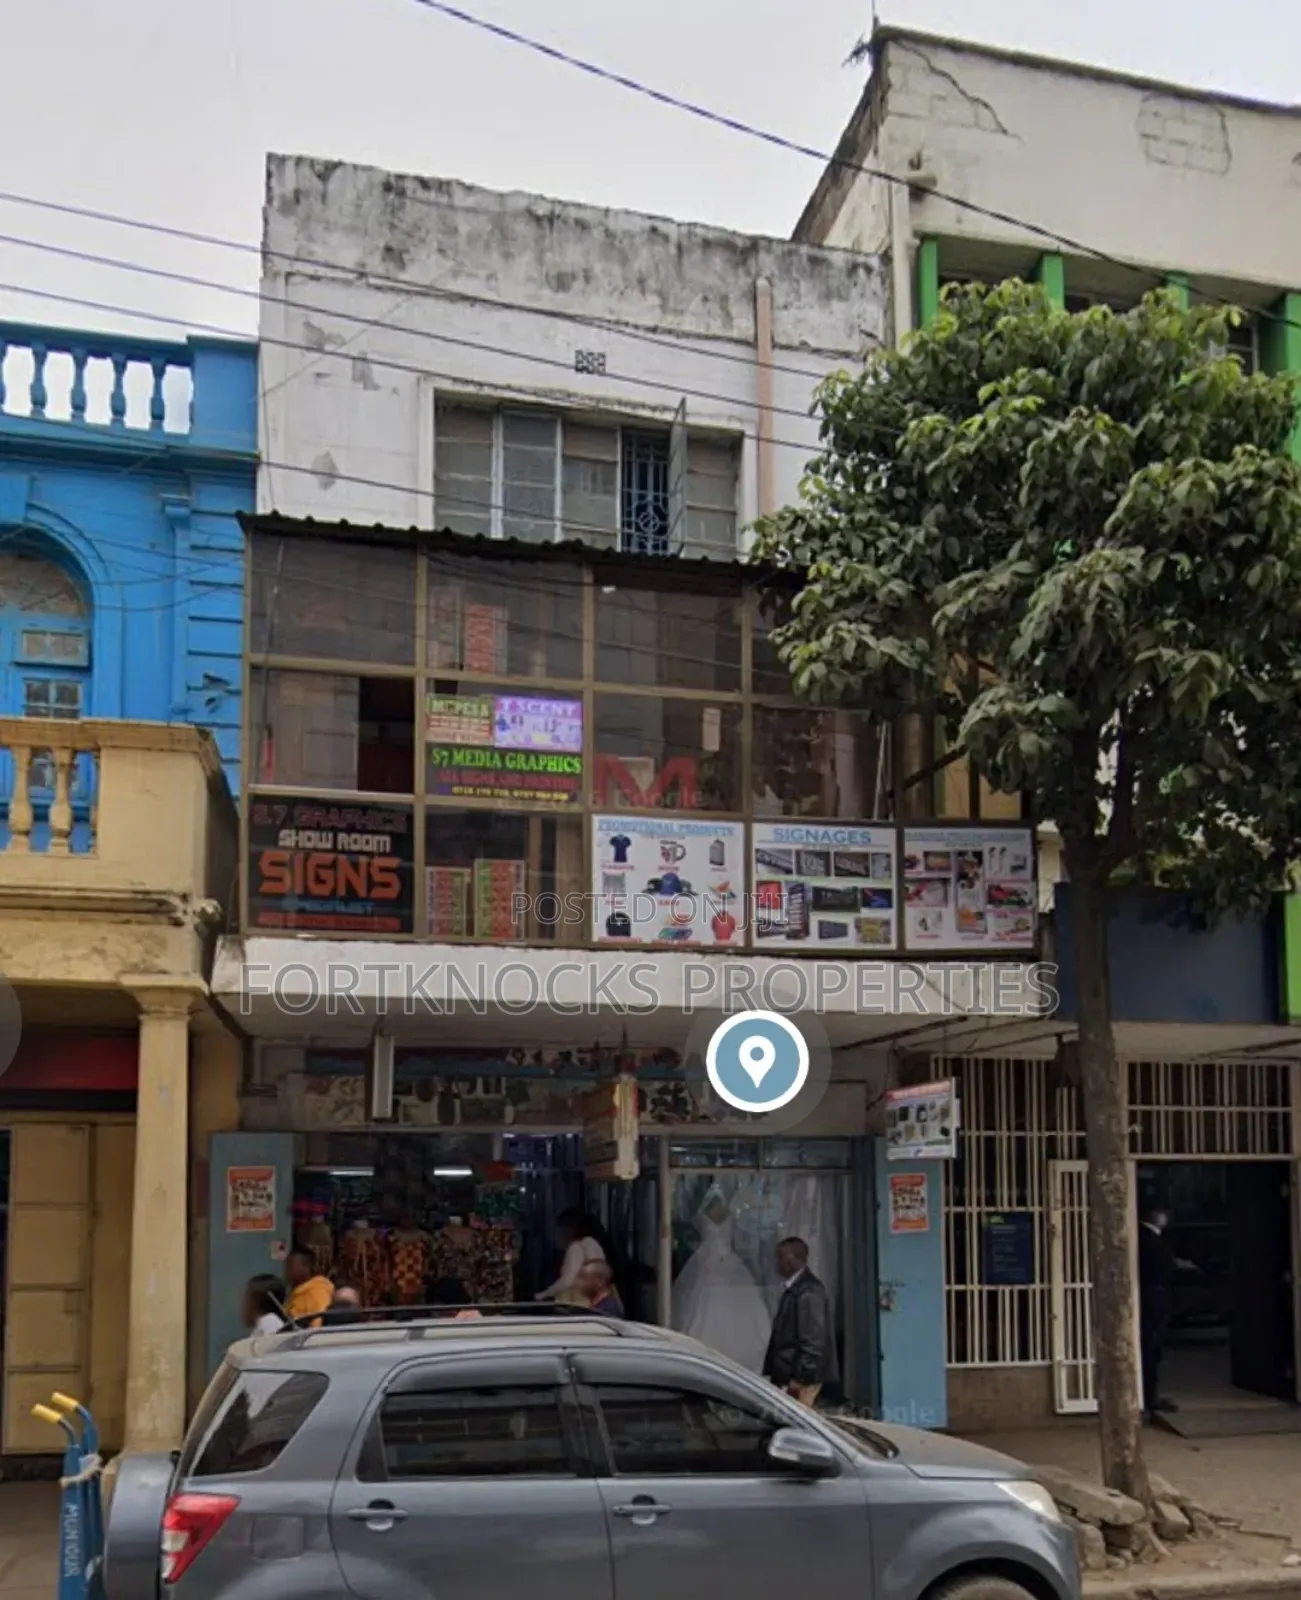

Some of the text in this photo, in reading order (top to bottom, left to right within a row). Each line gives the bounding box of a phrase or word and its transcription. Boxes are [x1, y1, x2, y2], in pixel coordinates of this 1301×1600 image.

[452, 748, 501, 768] MEDIA
[505, 752, 582, 774] GRAPHICS
[277, 829, 391, 853] SHOW ROOM
[772, 827, 872, 844] SIGNAGES
[258, 849, 404, 899] SIGNS
